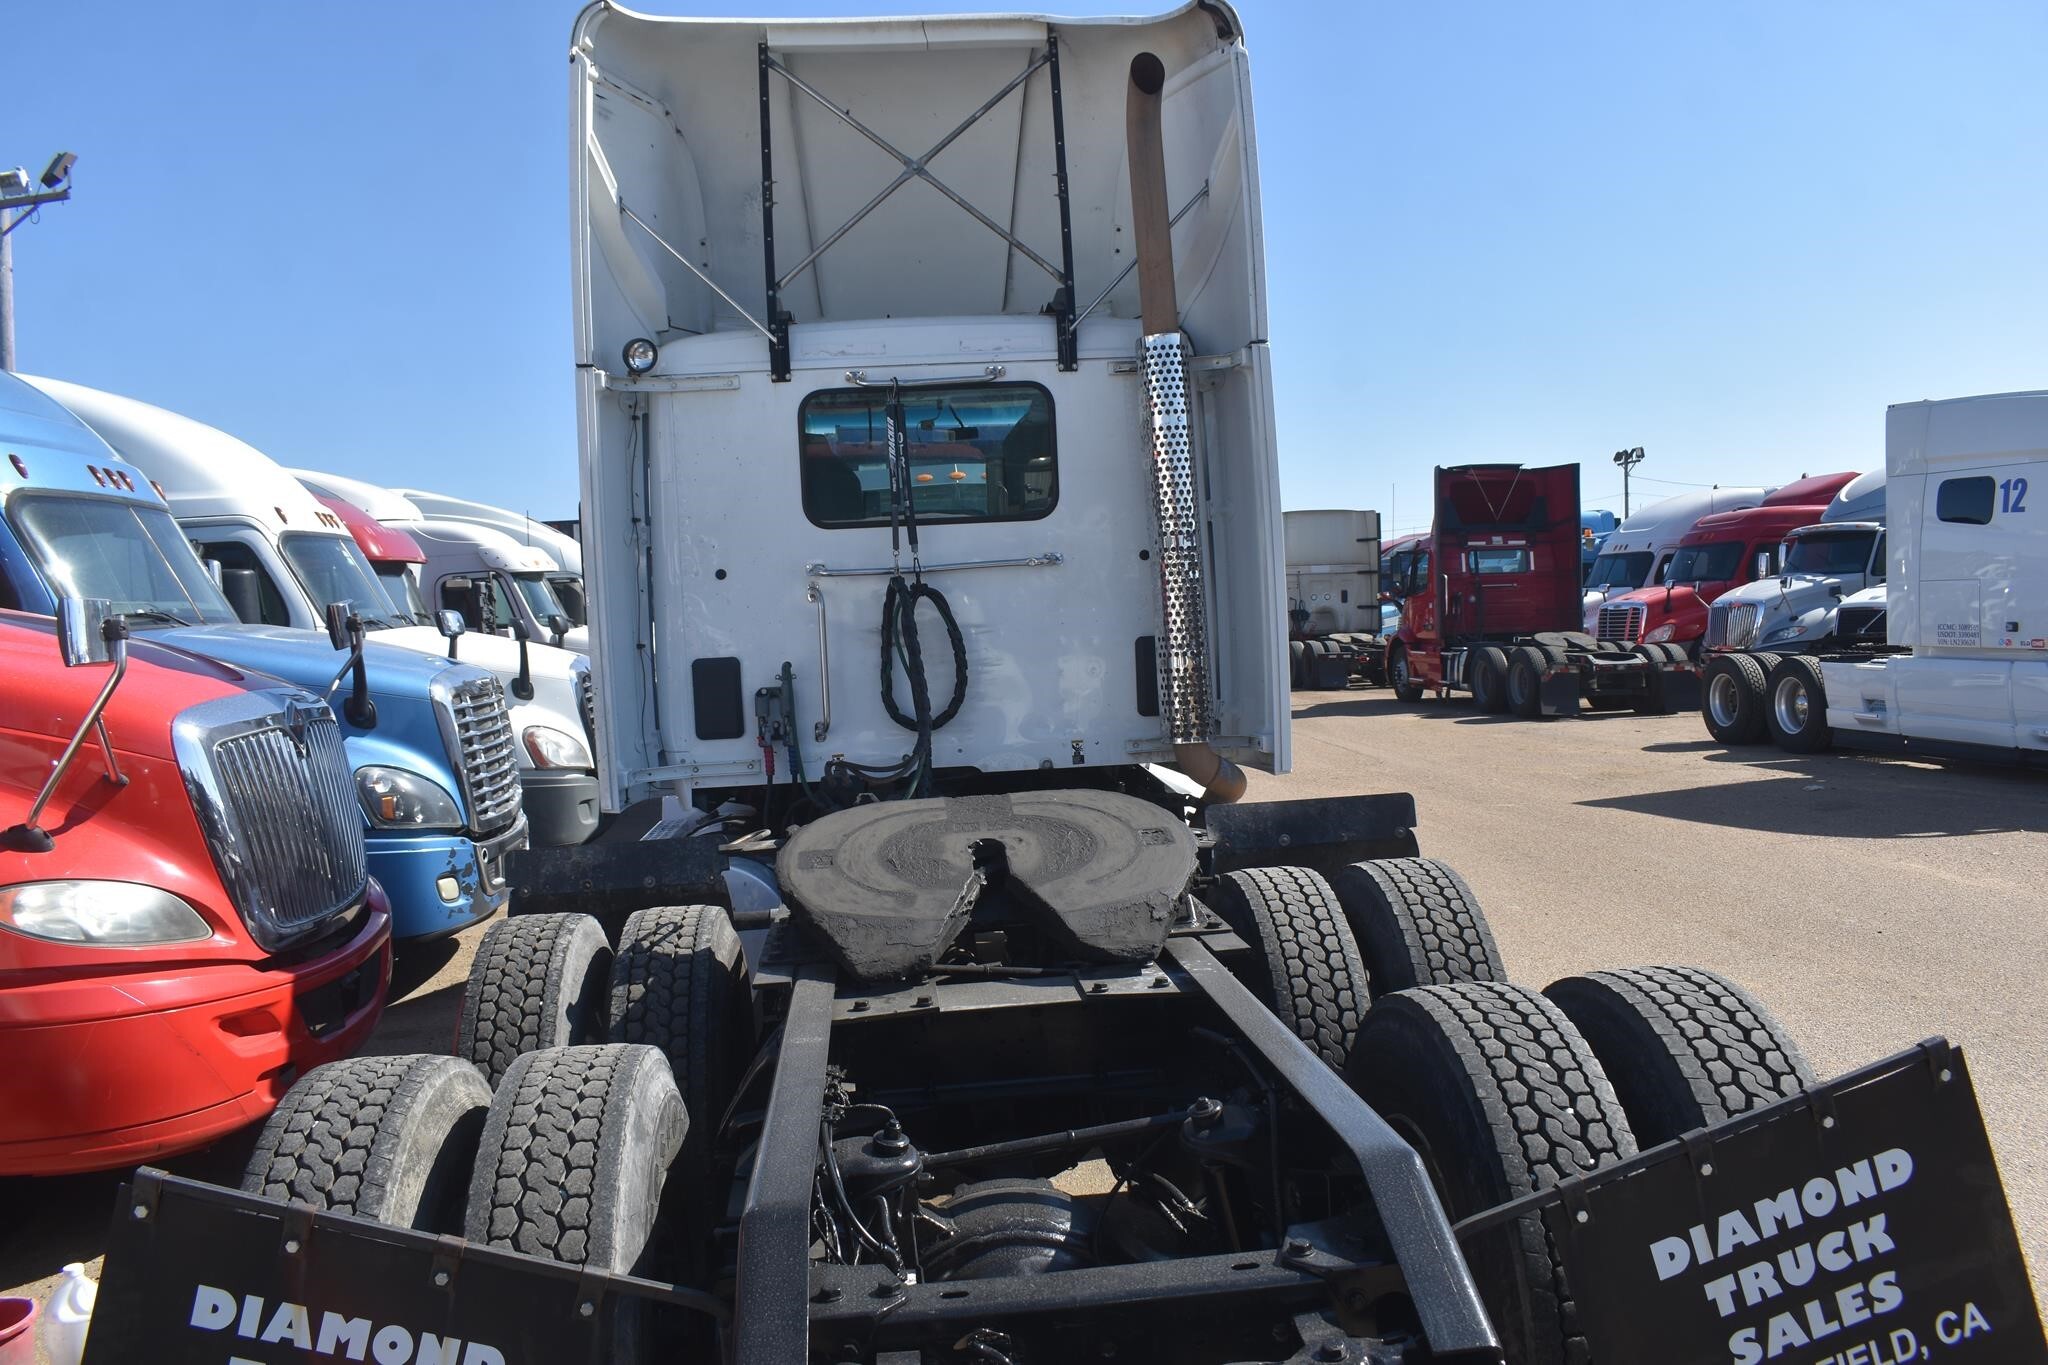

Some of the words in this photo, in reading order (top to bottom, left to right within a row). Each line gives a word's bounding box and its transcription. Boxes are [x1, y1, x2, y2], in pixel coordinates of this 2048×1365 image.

[2000, 477, 2028, 513] 12
[1649, 1148, 1913, 1281] DIAMOND
[1703, 1212, 1896, 1318] TRUCK
[189, 1284, 507, 1365] DIAMOND
[1728, 1271, 1903, 1365] SALES
[1935, 1302, 1992, 1344] CA
